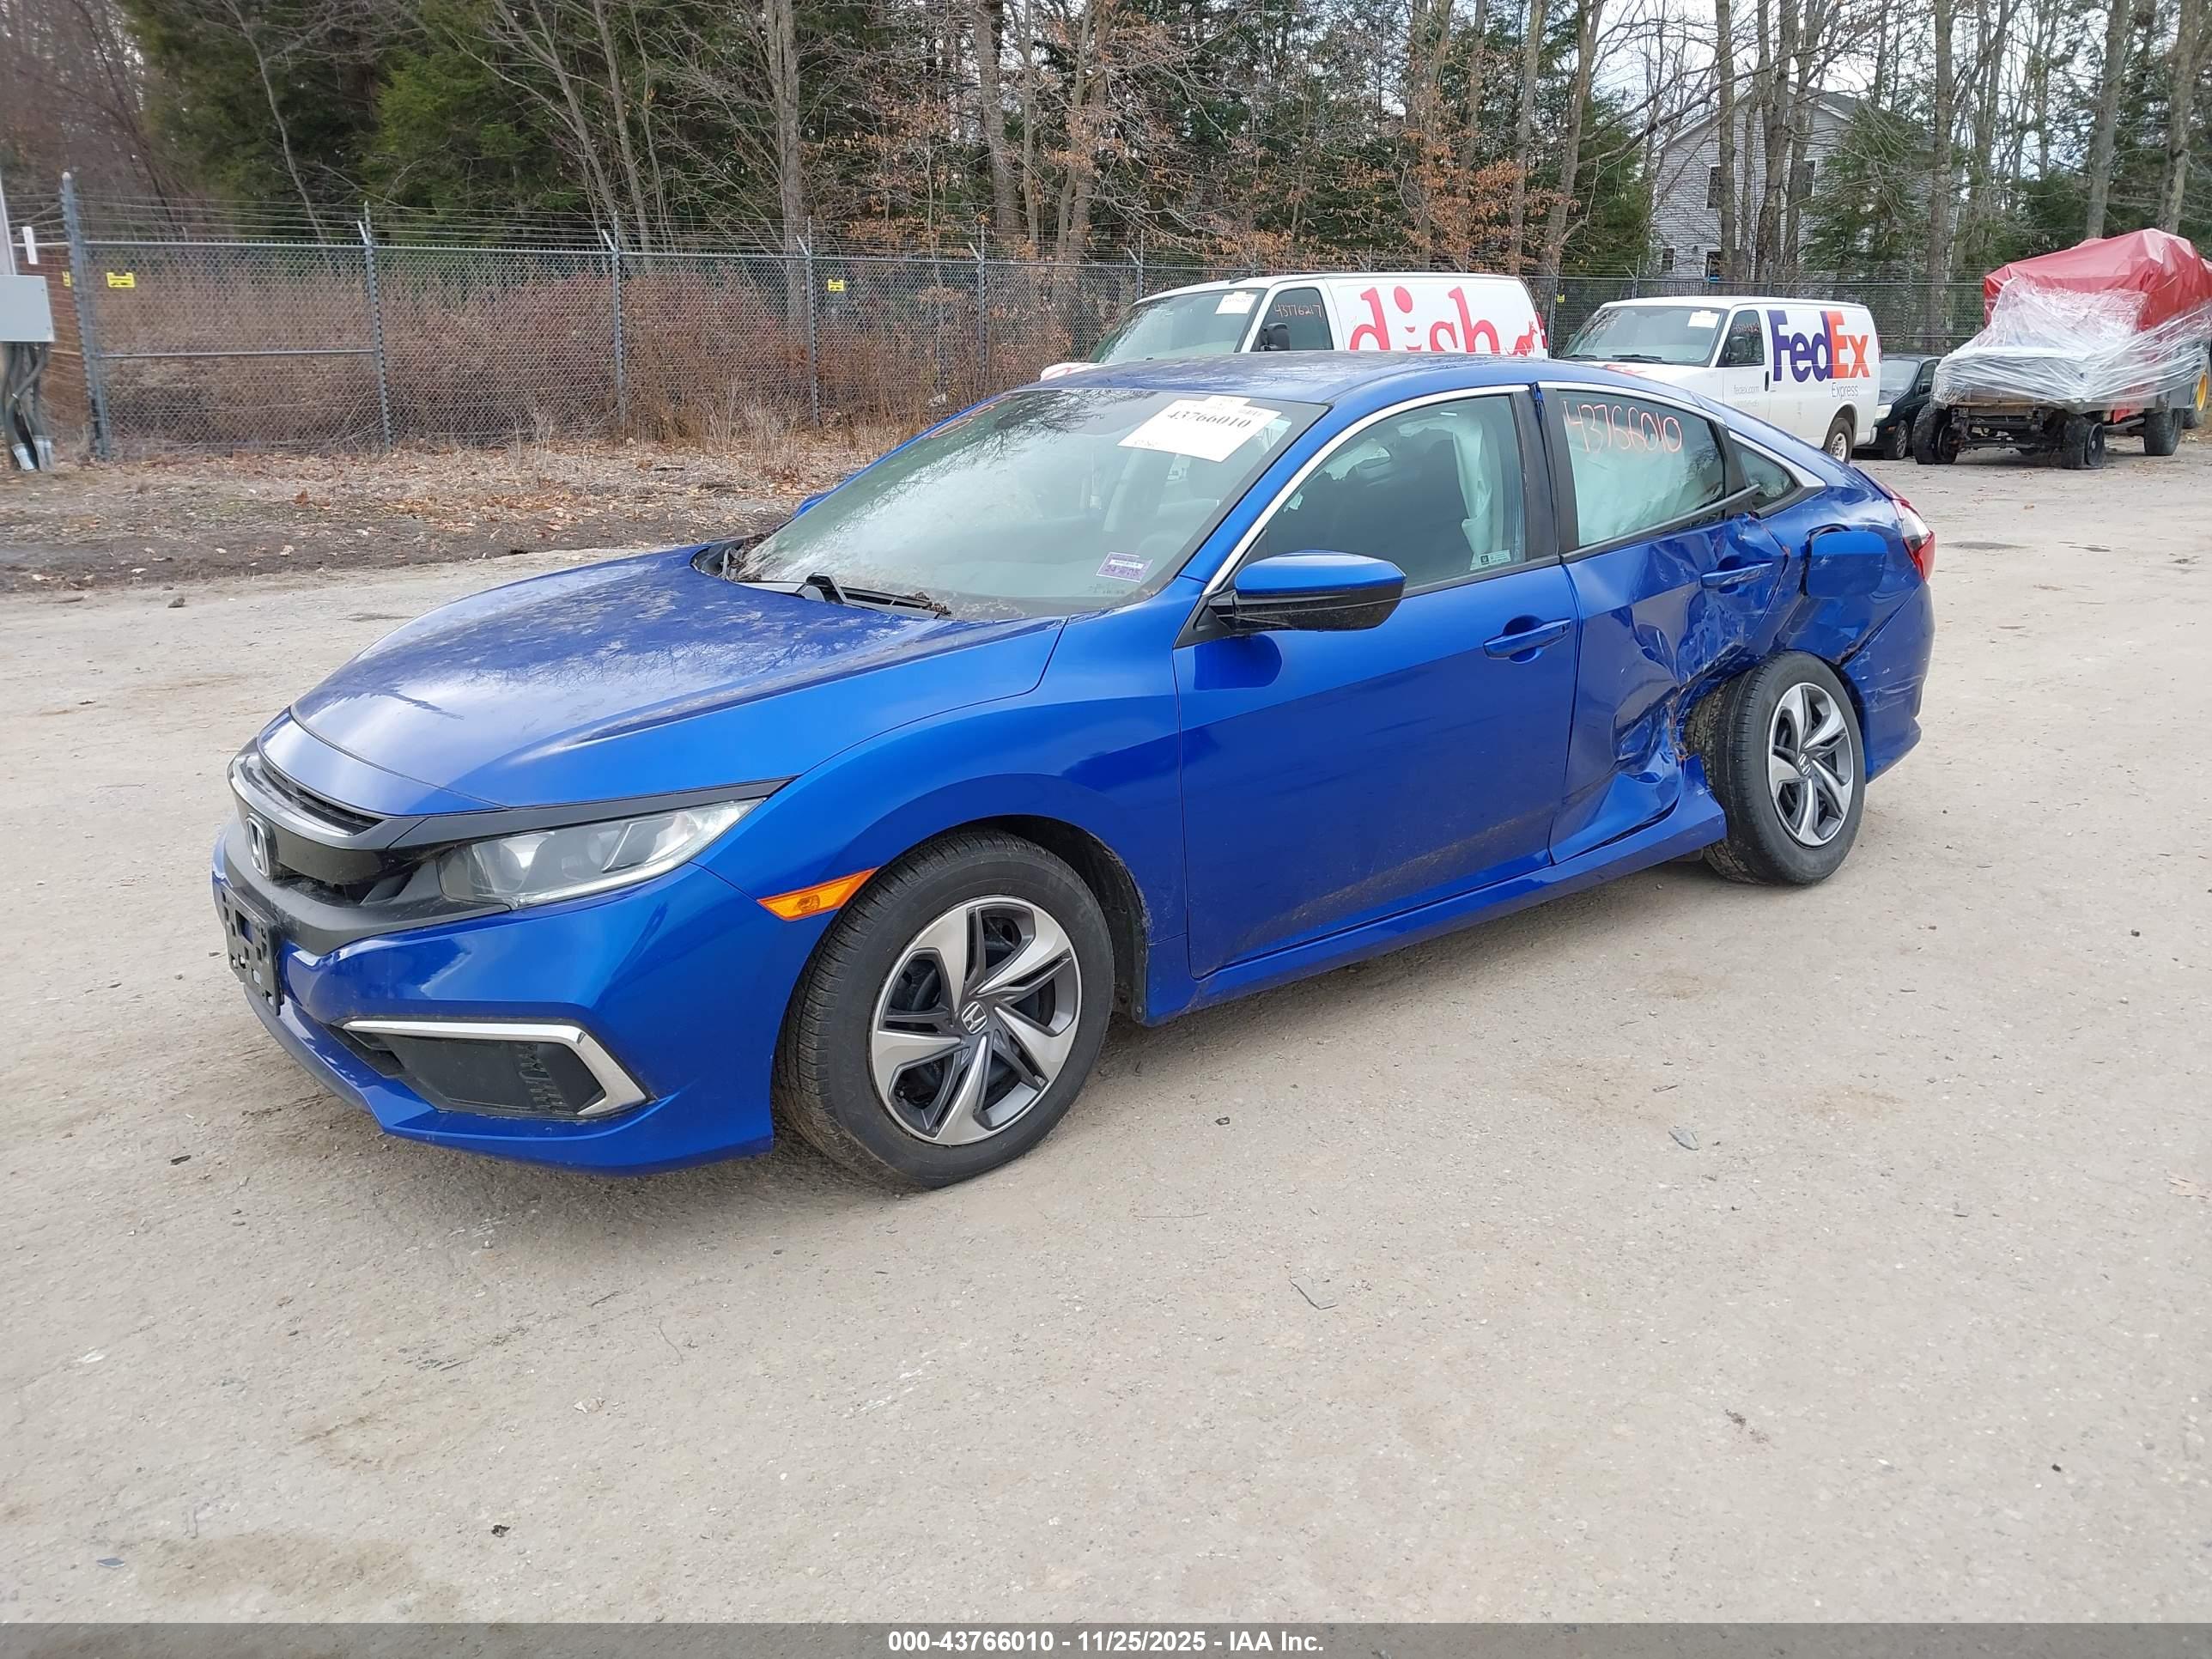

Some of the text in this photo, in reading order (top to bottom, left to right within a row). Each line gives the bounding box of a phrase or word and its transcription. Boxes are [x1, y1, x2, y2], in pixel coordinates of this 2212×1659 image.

[1767, 309, 1871, 383] FedEx
[1832, 382, 1859, 398] Express
[1168, 410, 1252, 428] 43766010
[1563, 400, 1684, 453] 43766010
